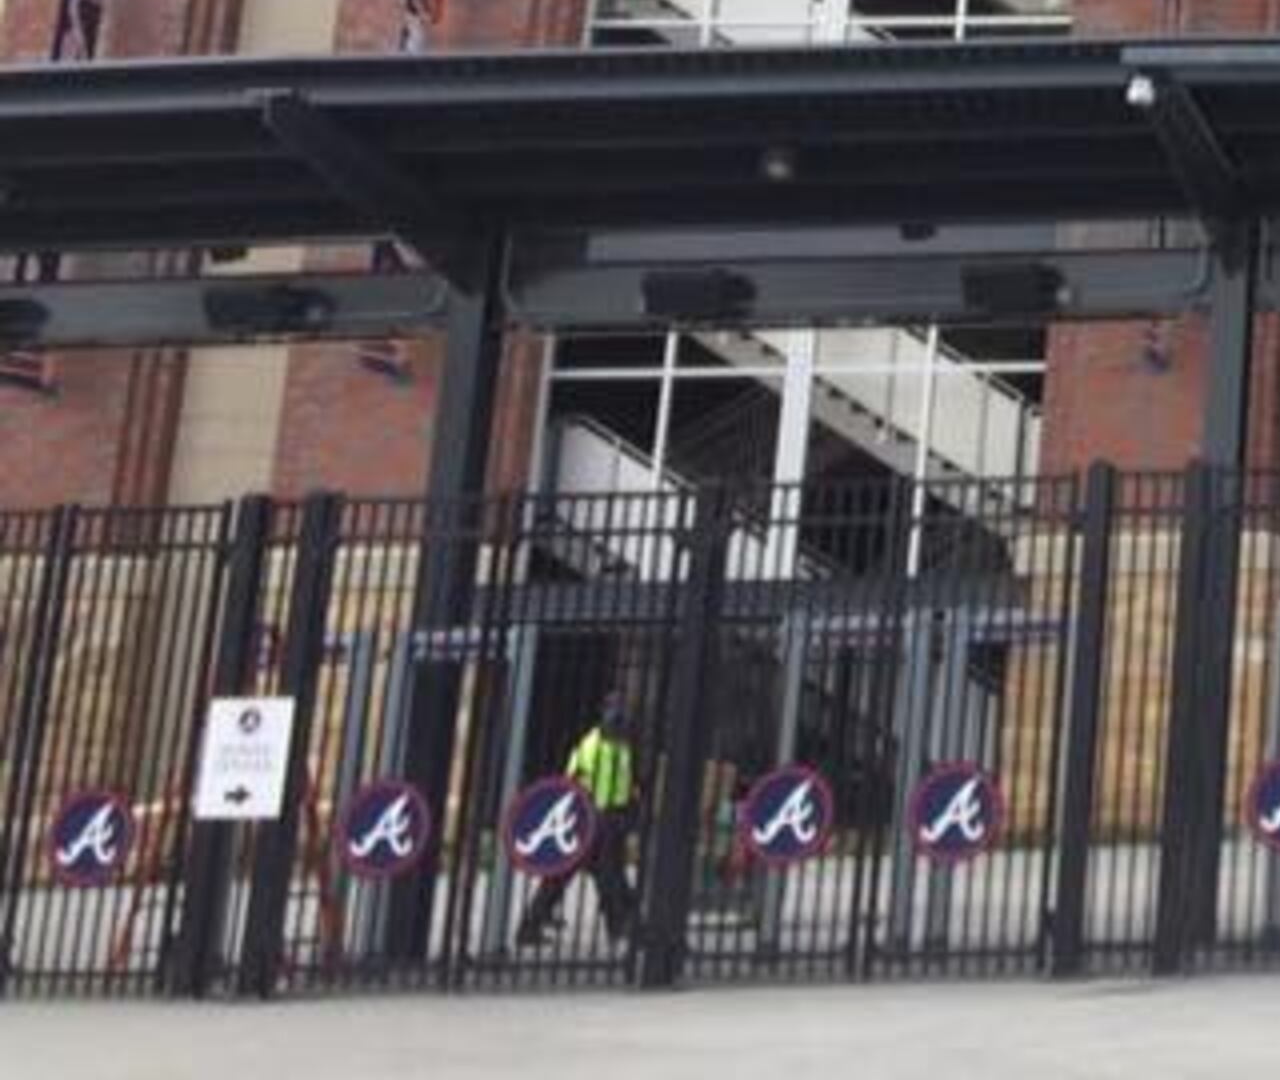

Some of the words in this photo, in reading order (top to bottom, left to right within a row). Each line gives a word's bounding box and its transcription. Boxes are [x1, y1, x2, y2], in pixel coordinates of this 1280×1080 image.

[56, 804, 116, 865] A
[350, 795, 412, 857] A
[515, 792, 578, 855] A
[752, 781, 816, 844] A
[920, 779, 984, 842] A
